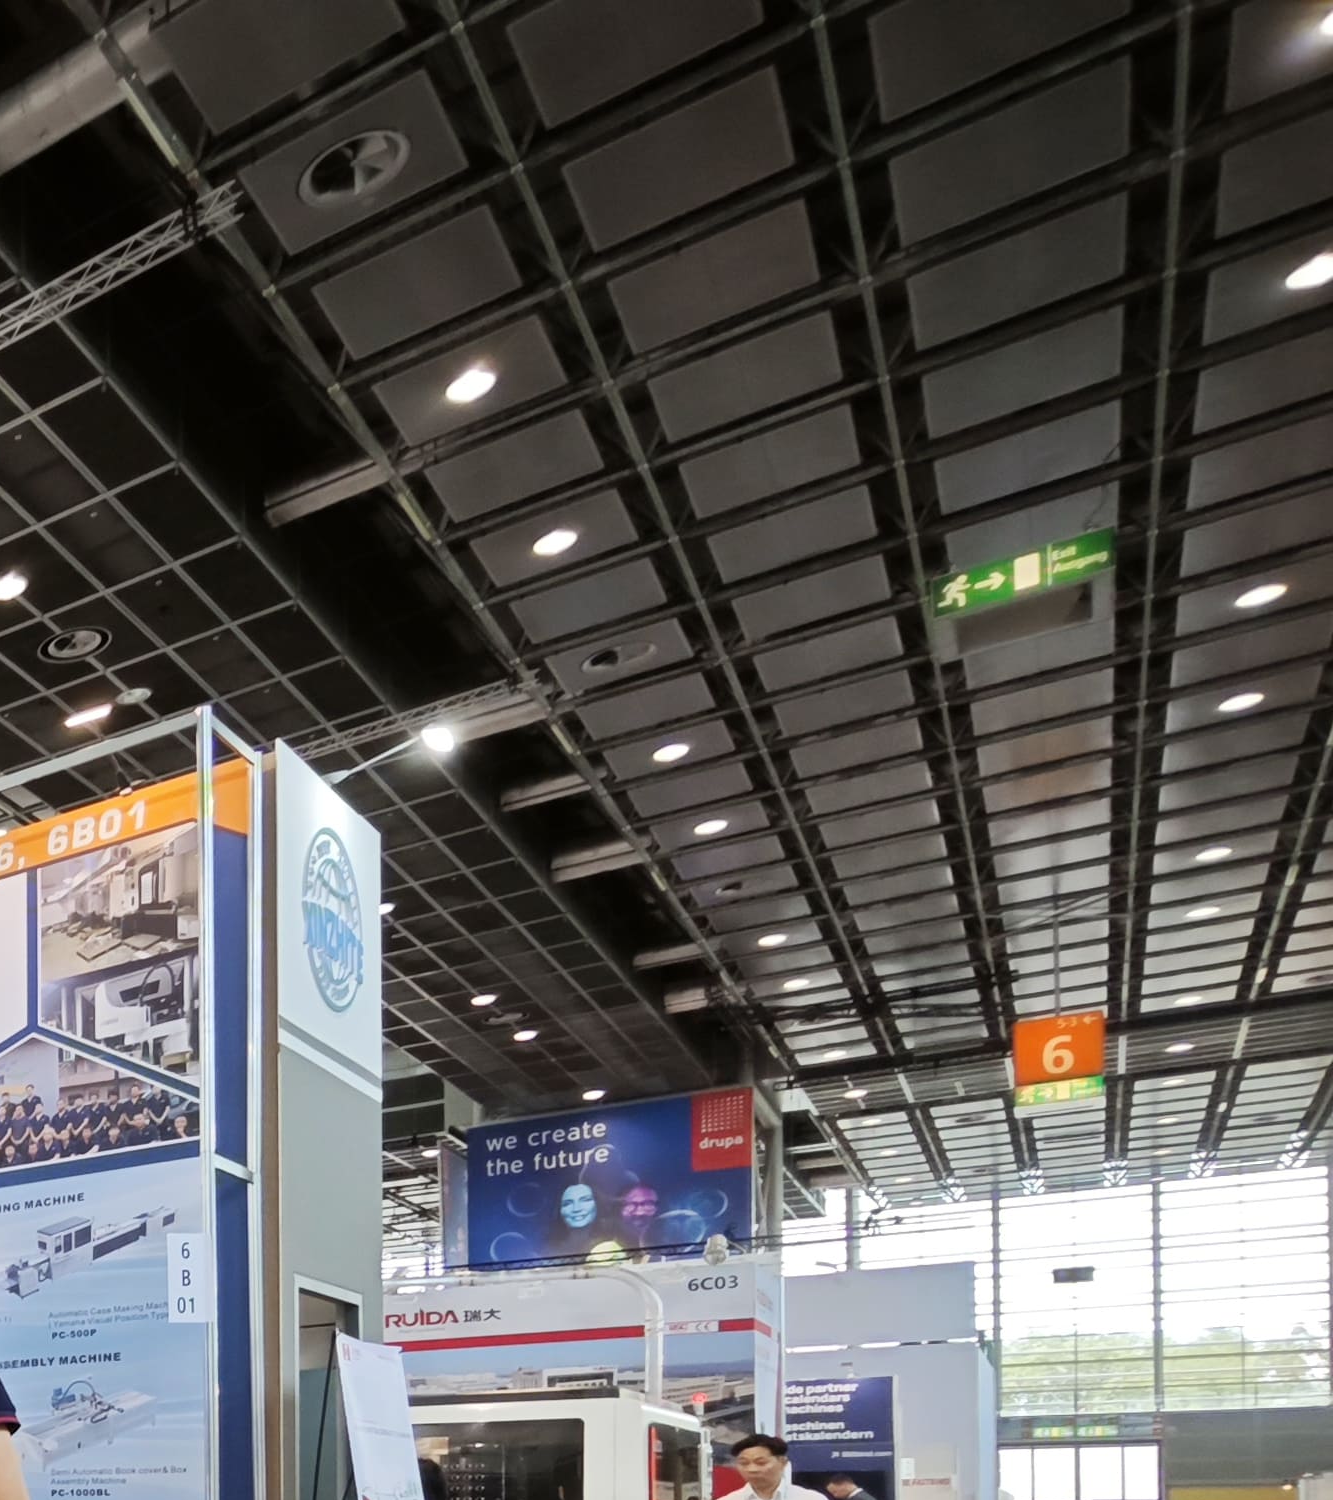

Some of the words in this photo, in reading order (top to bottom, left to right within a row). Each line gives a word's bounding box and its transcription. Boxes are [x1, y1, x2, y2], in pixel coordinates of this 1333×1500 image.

[46, 799, 148, 856] 6B01
[1041, 1034, 1075, 1075] 6
[485, 1134, 518, 1152] we
[527, 1121, 607, 1147] create
[699, 1135, 744, 1150] drupa
[486, 1158, 524, 1177] the
[533, 1149, 610, 1171] future
[24, 1192, 85, 1209] MACHINE
[180, 1241, 190, 1259] 6
[181, 1269, 192, 1287] B
[687, 1275, 739, 1292] 6C03
[176, 1296, 196, 1315] 01
[384, 1308, 459, 1329] RUIDA
[463, 1308, 502, 1323] 瑞大
[51, 1328, 98, 1340] PC-500P
[59, 1351, 122, 1365] MACHINE
[50, 1488, 111, 1498] PC-1000BL
